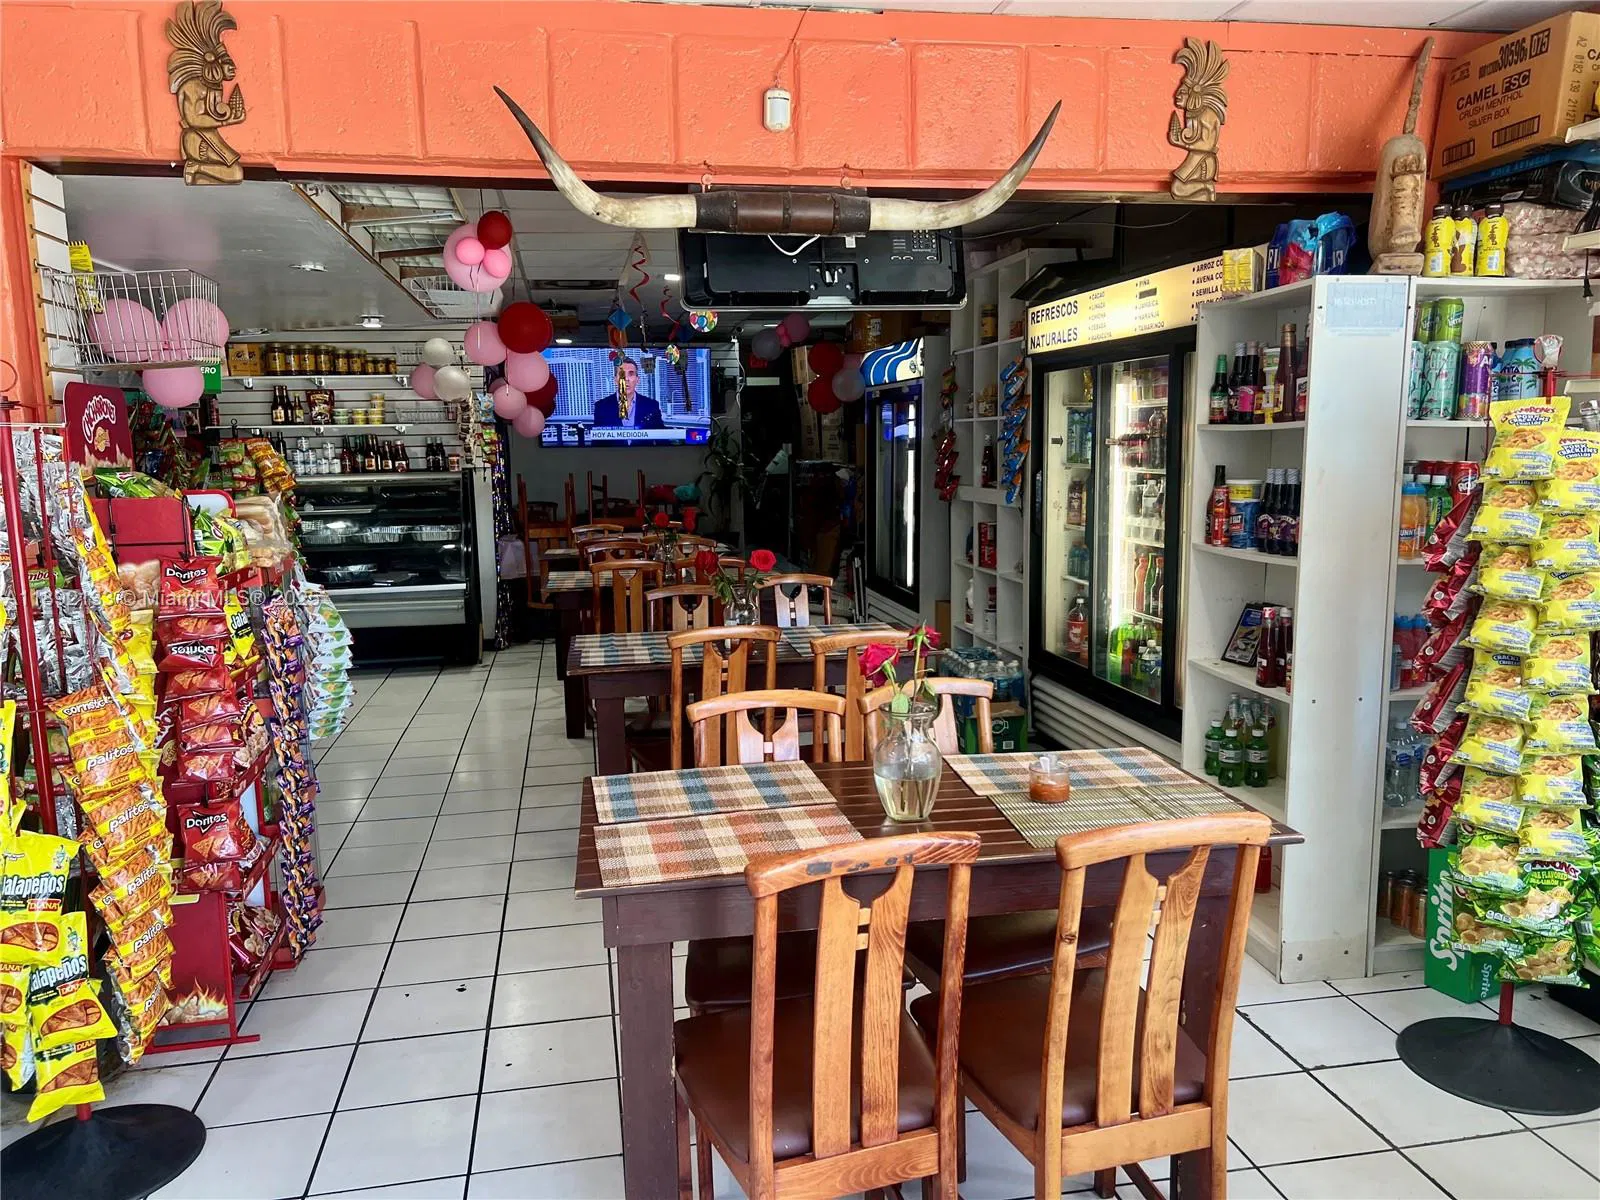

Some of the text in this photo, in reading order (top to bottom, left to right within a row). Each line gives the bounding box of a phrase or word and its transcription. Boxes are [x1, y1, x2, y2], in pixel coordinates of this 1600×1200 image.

[1456, 72, 1529, 110] CAMEL FSC
[1459, 90, 1524, 121] CRUSH MENTHOL
[1468, 106, 1511, 130] SILVER BOX
[1196, 261, 1214, 272] ARROZ
[1195, 285, 1219, 296] SEMILLA
[1196, 274, 1214, 284] AVENA
[1030, 300, 1078, 325] REFRESCOS
[1030, 327, 1078, 350] NATURALES
[166, 568, 207, 579] Doritos
[171, 645, 215, 655] Doritos
[86, 744, 134, 771] palitos
[109, 801, 151, 833] palitos
[187, 813, 227, 829] Doritos
[31, 956, 87, 992] alapeños
[1480, 963, 1492, 998] Sprite
